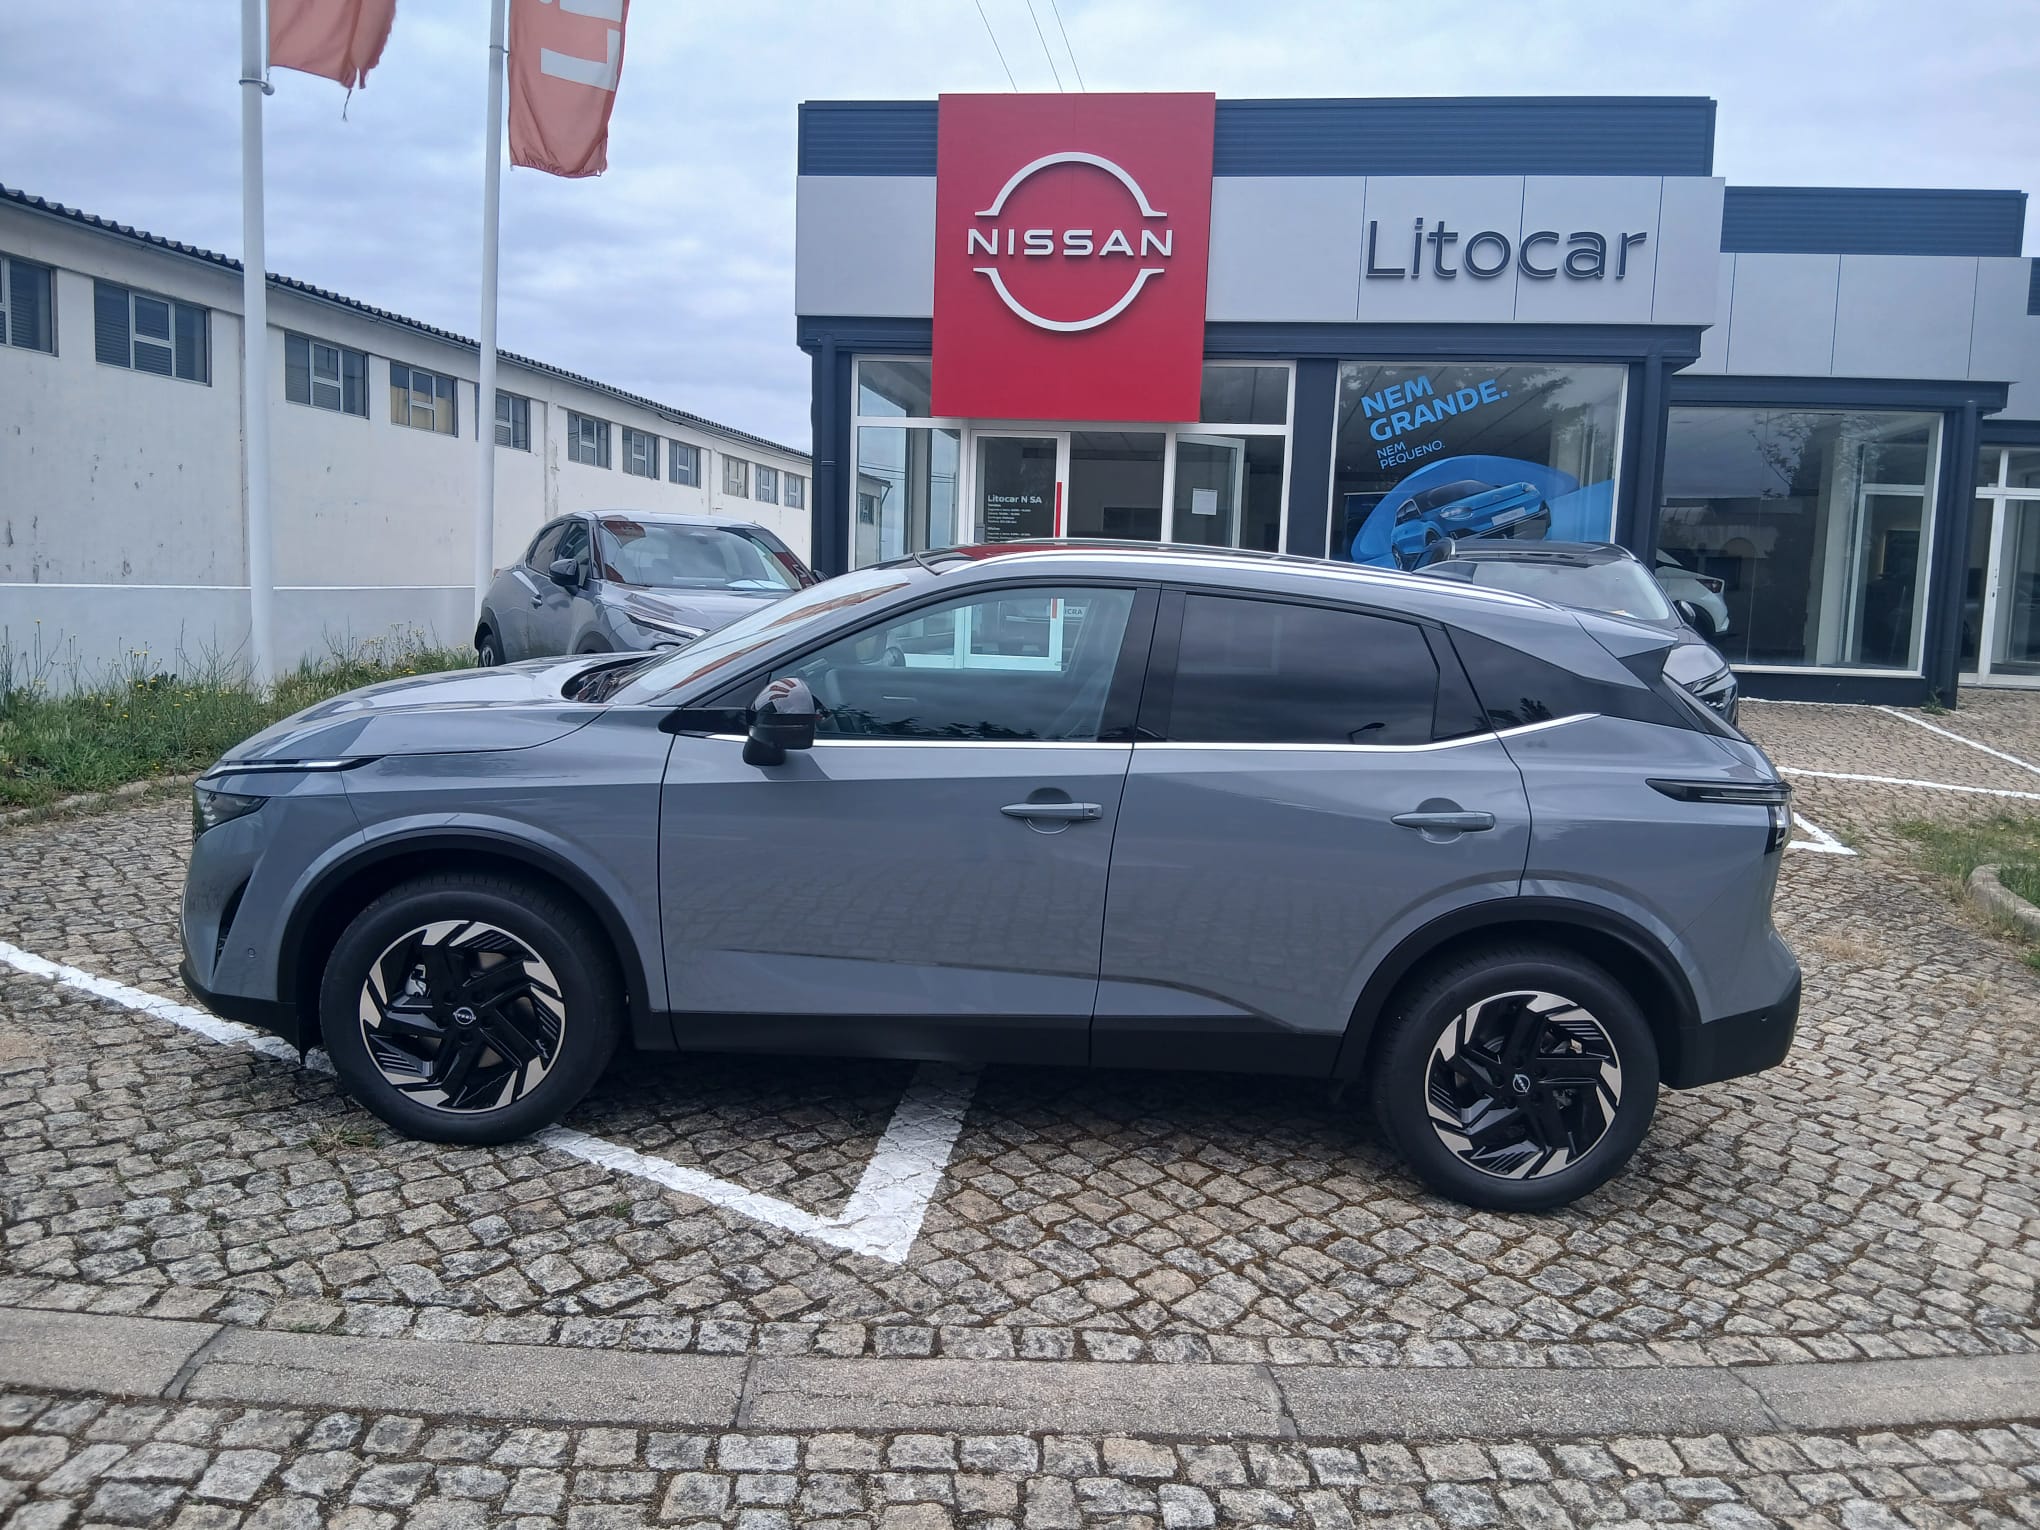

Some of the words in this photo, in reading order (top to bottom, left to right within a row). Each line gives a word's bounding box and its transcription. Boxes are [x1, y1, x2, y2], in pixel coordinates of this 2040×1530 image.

[967, 229, 1173, 256] NISSAN
[1366, 217, 1648, 279] Litocar
[1361, 375, 1433, 418] NEM
[1370, 379, 1509, 441] GRANDE.
[1377, 441, 1406, 459] NEM
[1380, 440, 1446, 470] PEQUENO.
[987, 494, 1019, 503] Litocar
[1029, 496, 1042, 504] SA
